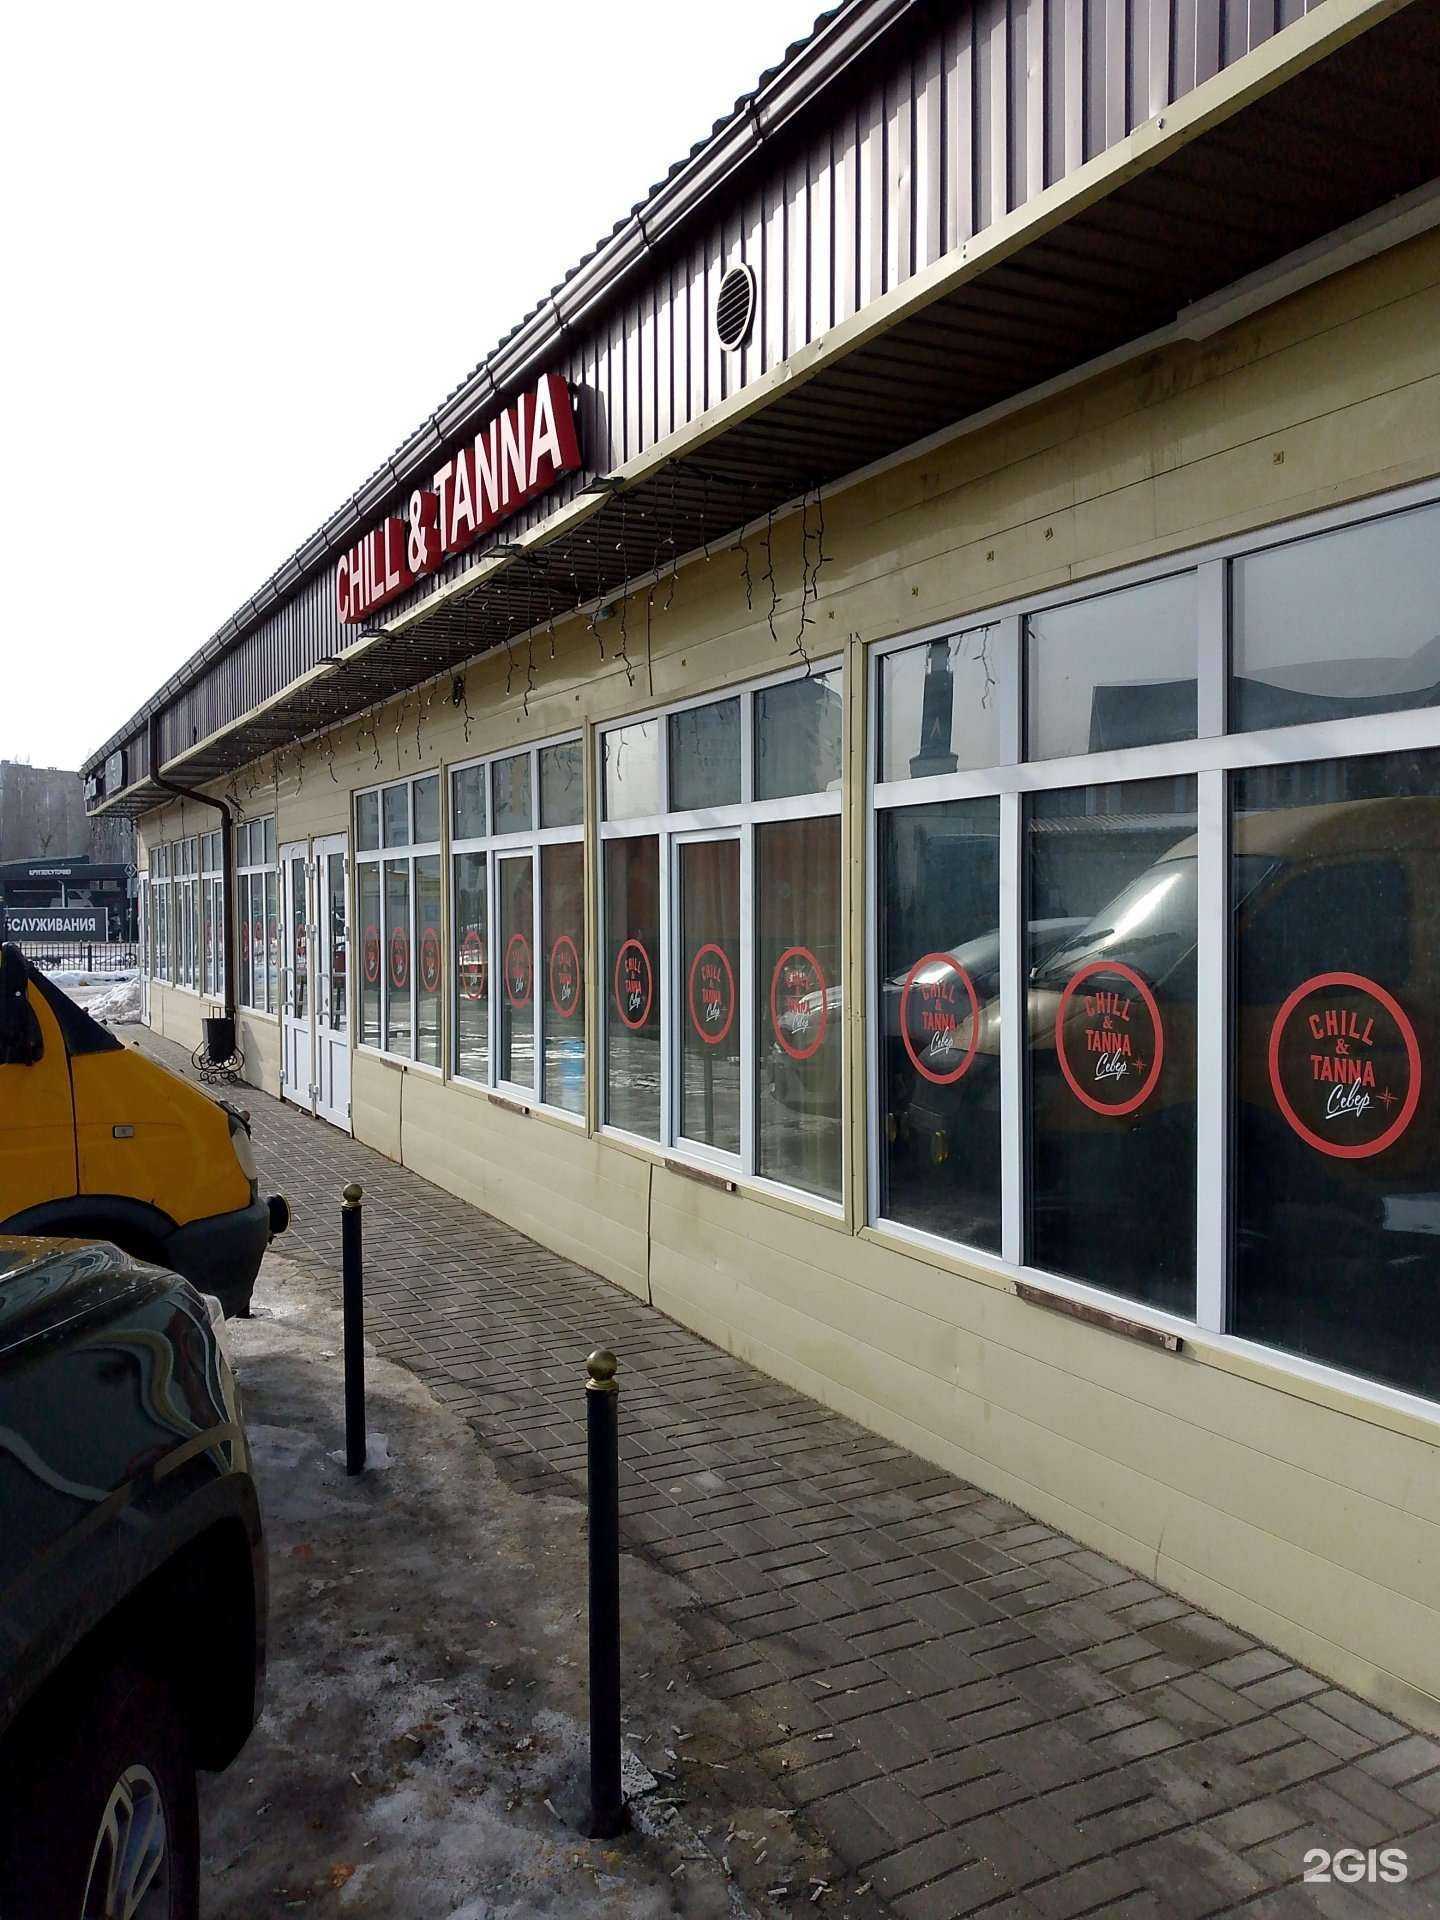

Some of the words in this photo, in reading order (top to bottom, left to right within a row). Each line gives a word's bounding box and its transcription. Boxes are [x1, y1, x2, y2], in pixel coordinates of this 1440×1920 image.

[336, 517, 400, 624] CHILL
[408, 489, 428, 574] &
[433, 373, 562, 552] TANNA
[5, 917, 96, 932] БСЛУЖИВАНИЯ
[921, 983, 956, 1004] CHILL
[1084, 991, 1130, 1021] CHILL
[921, 1011, 958, 1031] TANNA
[1103, 1016, 1113, 1029] &
[1308, 1010, 1374, 1046] CHILL
[1086, 1029, 1132, 1056] TANNA
[1335, 1039, 1350, 1055] &
[1094, 1048, 1128, 1080] Север
[1310, 1054, 1376, 1088] TANNA
[1325, 1077, 1373, 1119] Север
